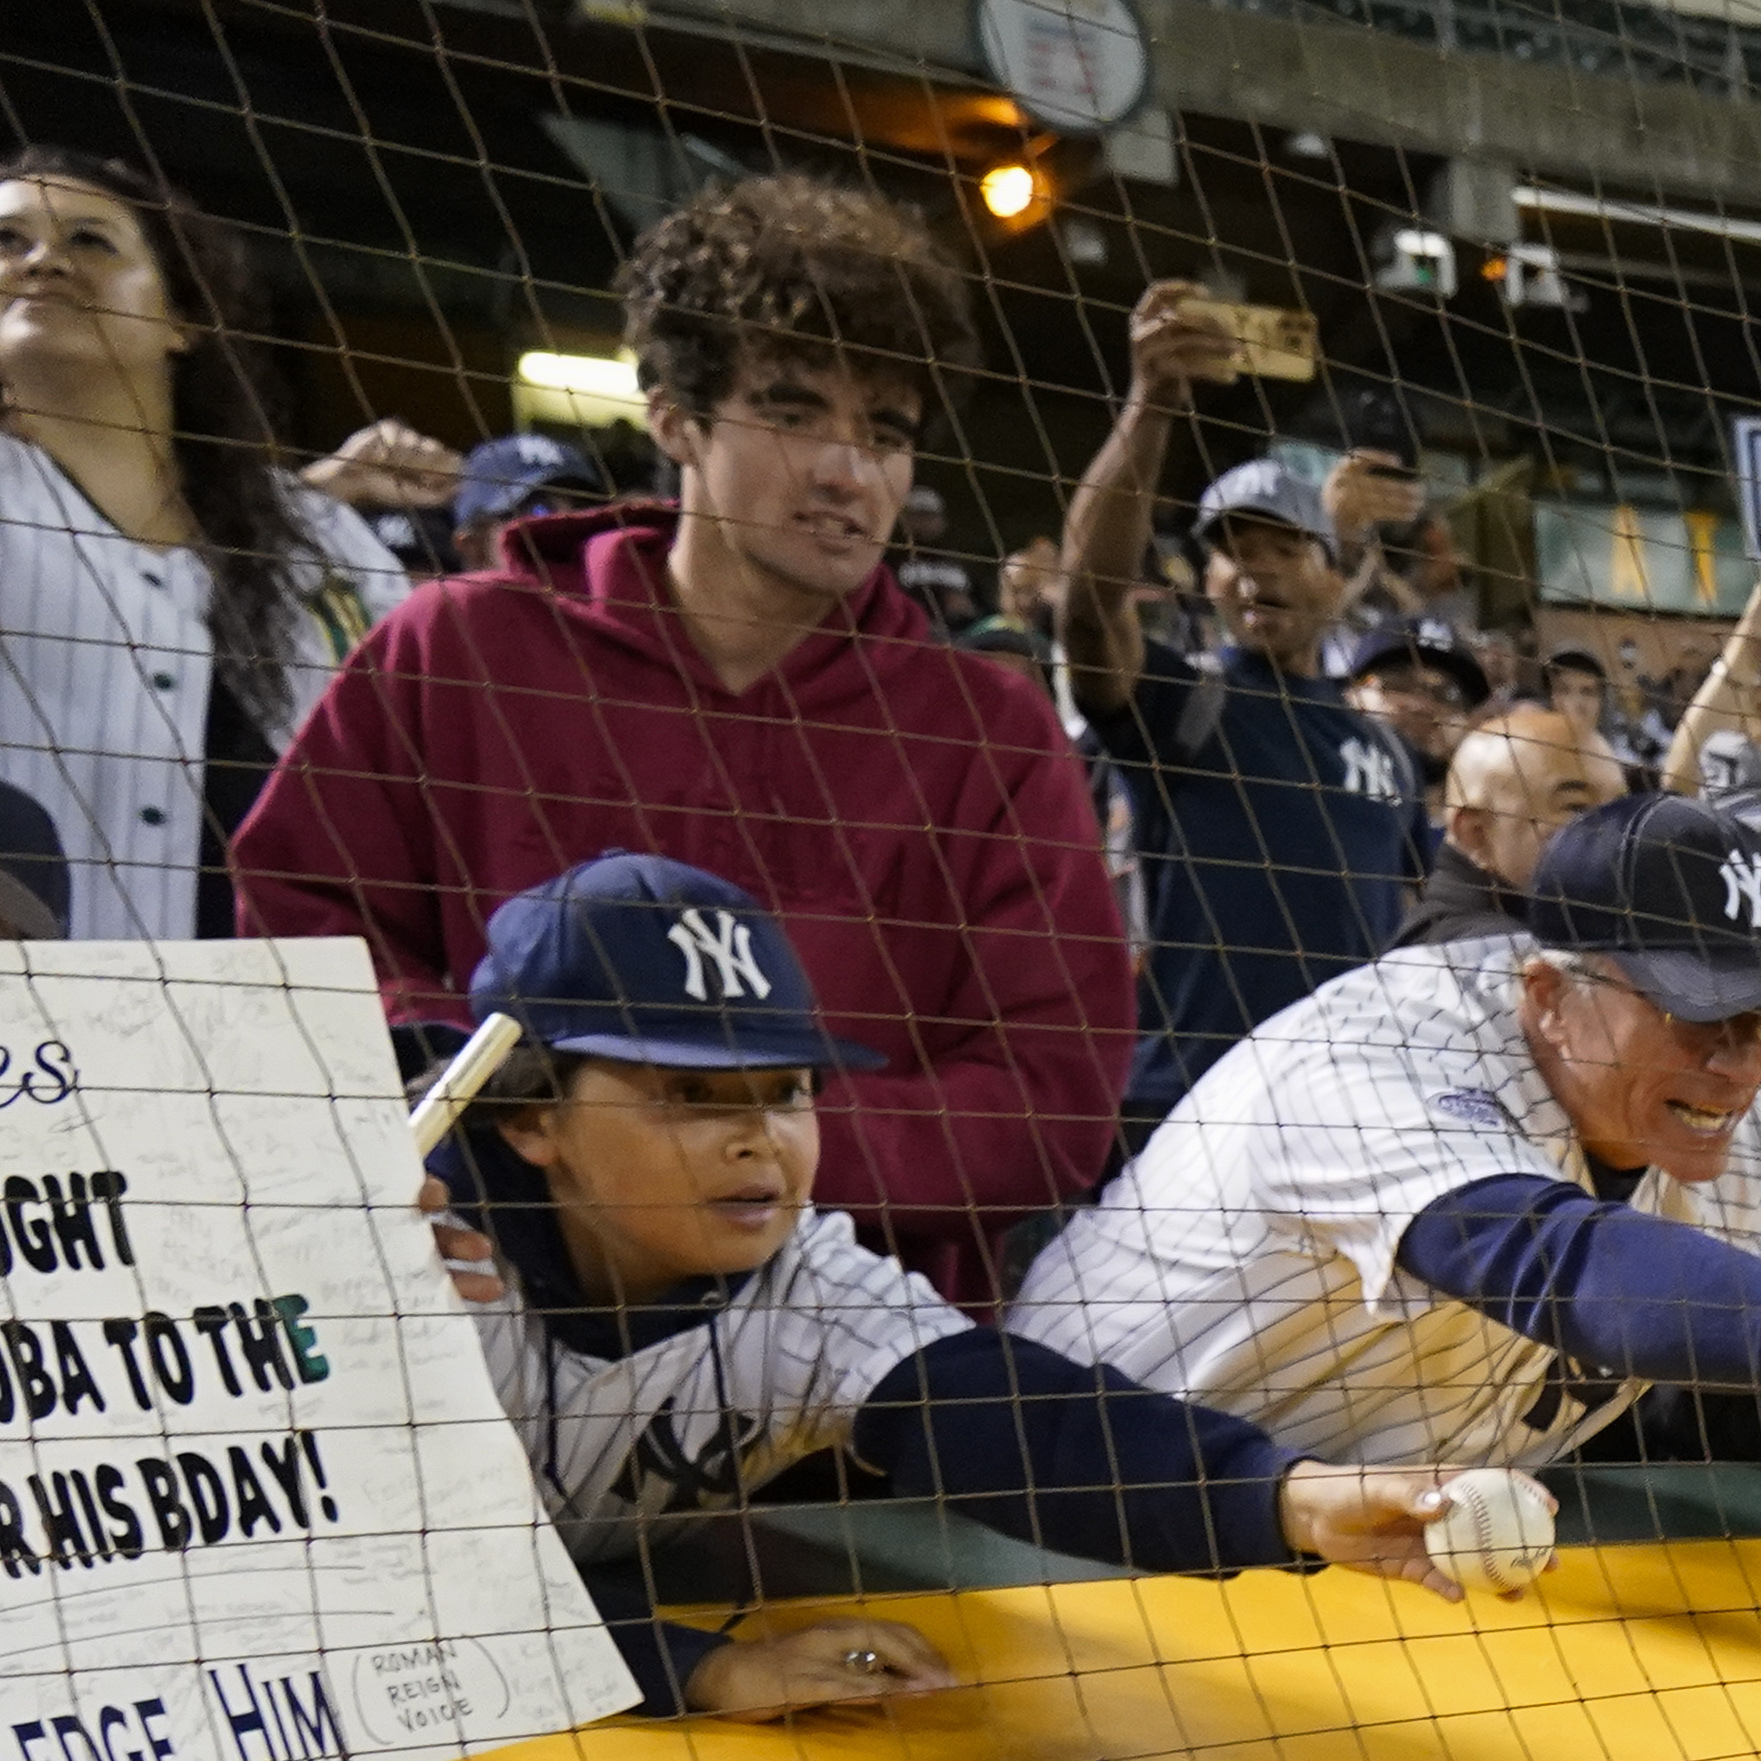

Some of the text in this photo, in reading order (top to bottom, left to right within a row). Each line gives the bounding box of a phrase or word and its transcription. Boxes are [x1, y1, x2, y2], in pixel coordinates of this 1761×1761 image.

[667, 908, 772, 1001] NY
[103, 1311, 195, 1411] TO
[193, 1294, 330, 1397] THE
[27, 1463, 143, 1571] HIS
[137, 1430, 338, 1551] BDAY!
[387, 1668, 463, 1706] REIGN
[396, 1698, 474, 1733] VOICE
